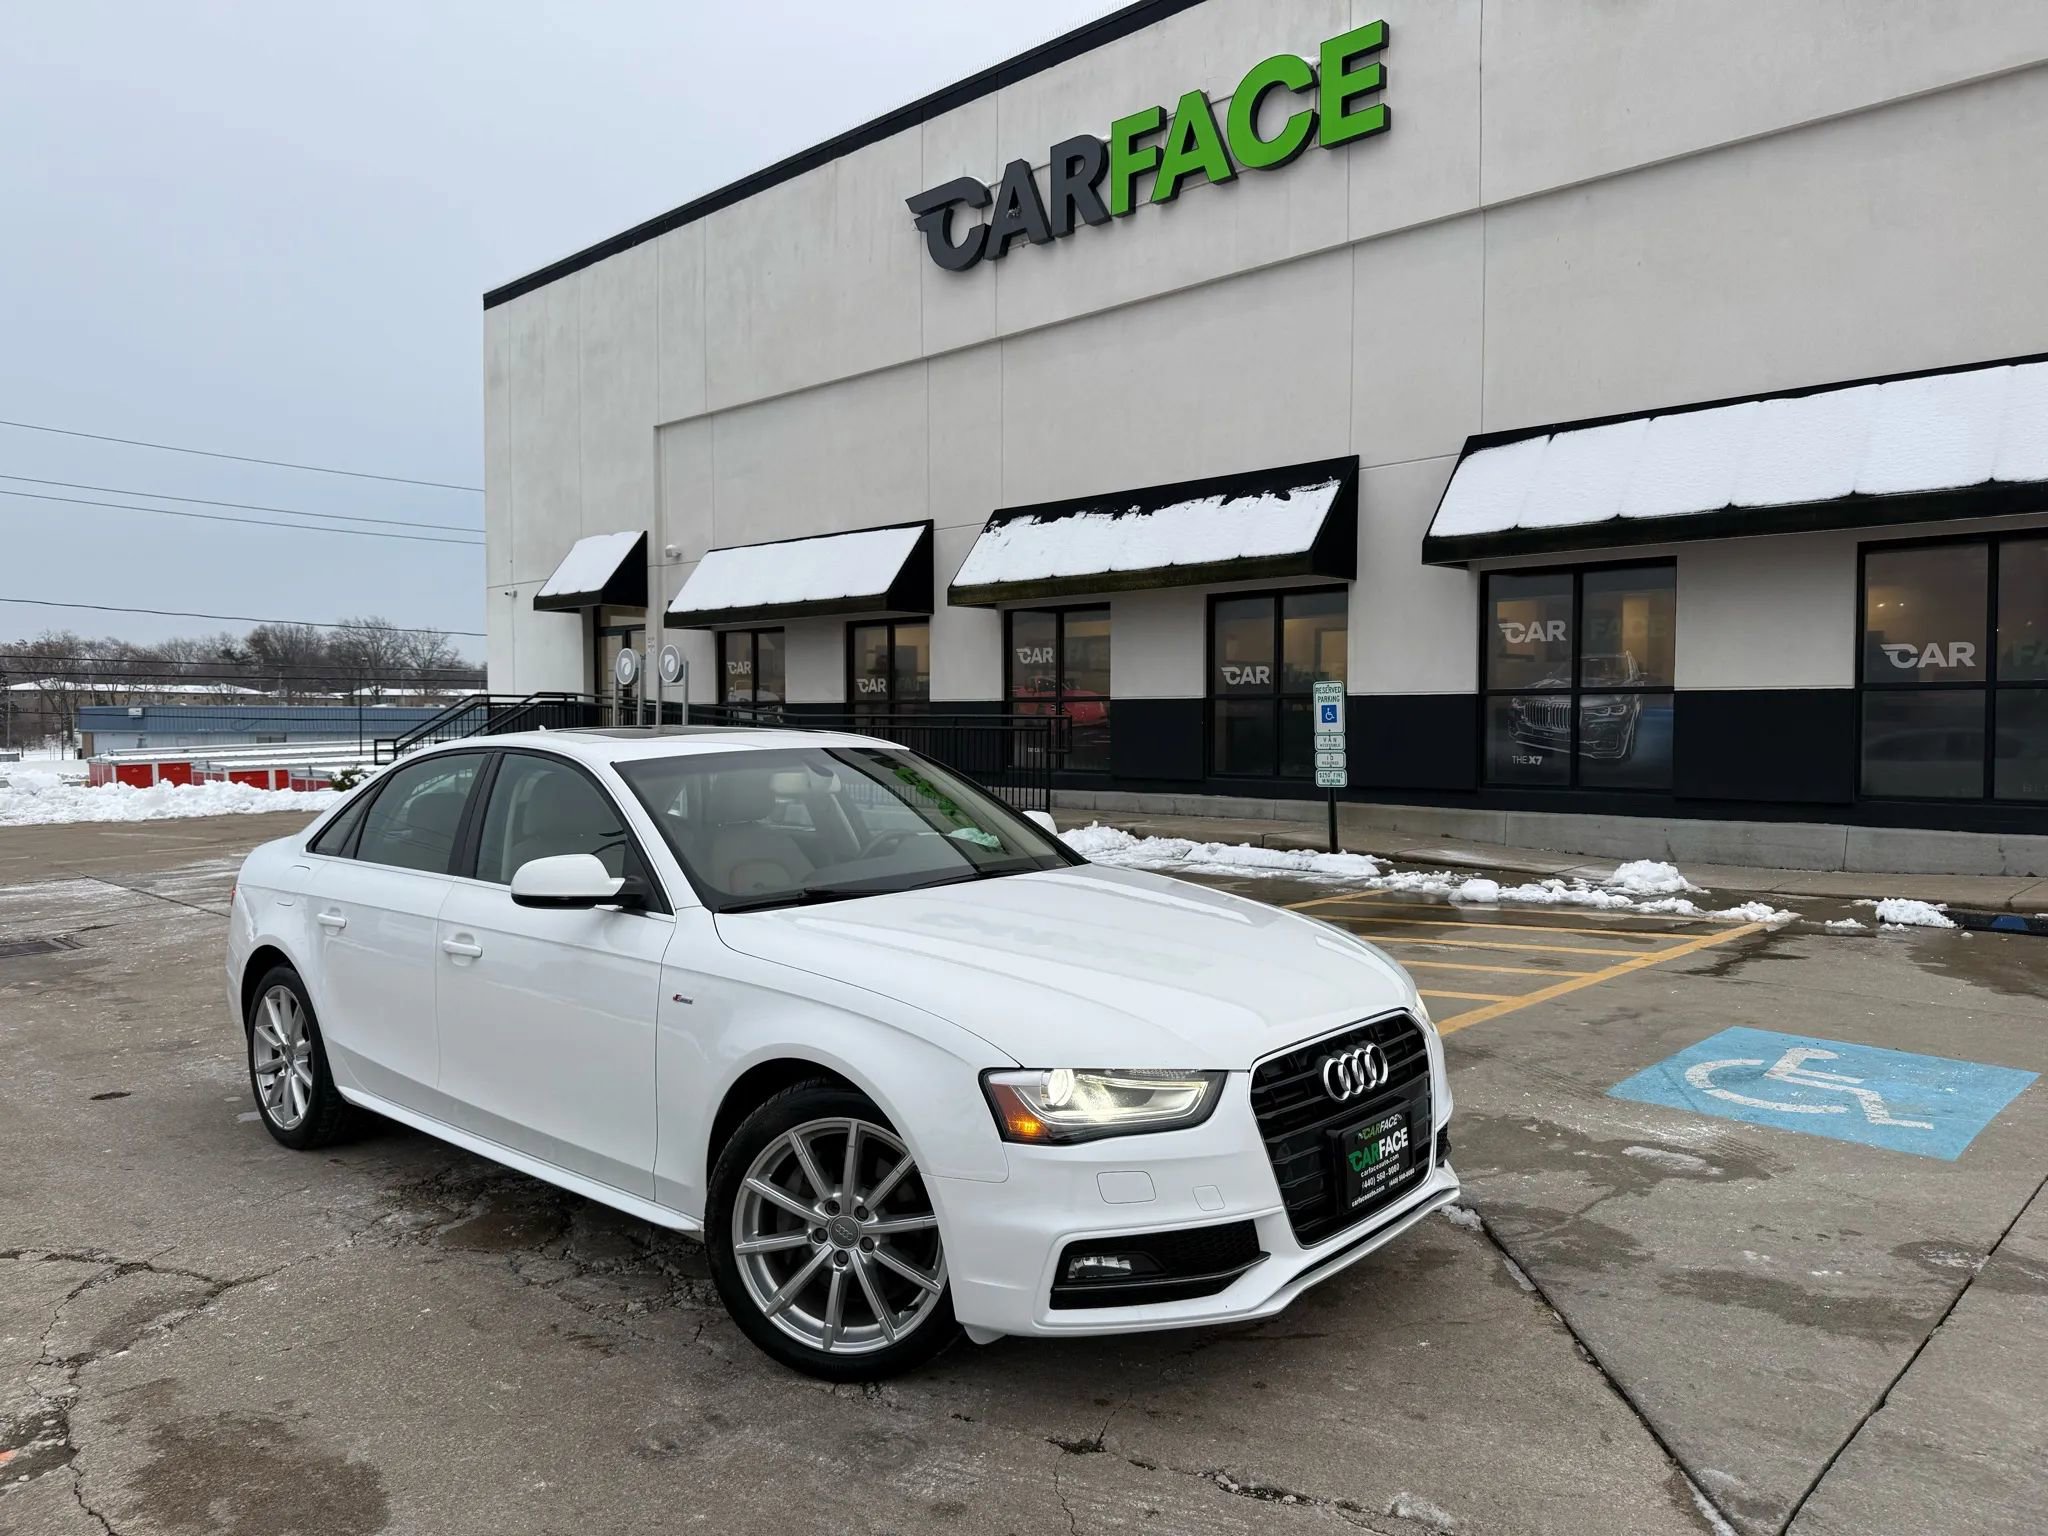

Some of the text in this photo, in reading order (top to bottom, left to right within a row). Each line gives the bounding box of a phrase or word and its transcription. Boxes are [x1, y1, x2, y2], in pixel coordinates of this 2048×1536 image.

[905, 19, 1391, 272] CARFACE
[1498, 620, 1567, 644] CAR
[1016, 647, 1054, 665] CAR
[1880, 641, 1976, 669] CAR
[726, 661, 752, 675] CAR
[1220, 665, 1271, 686] CAR
[856, 677, 887, 694] CAR
[1315, 686, 1341, 694] RESERVED
[1317, 695, 1340, 703] PARKING
[1511, 755, 1543, 766] THE X7
[1361, 1113, 1399, 1140] CARFACE
[1348, 1126, 1409, 1173] CARFACE
